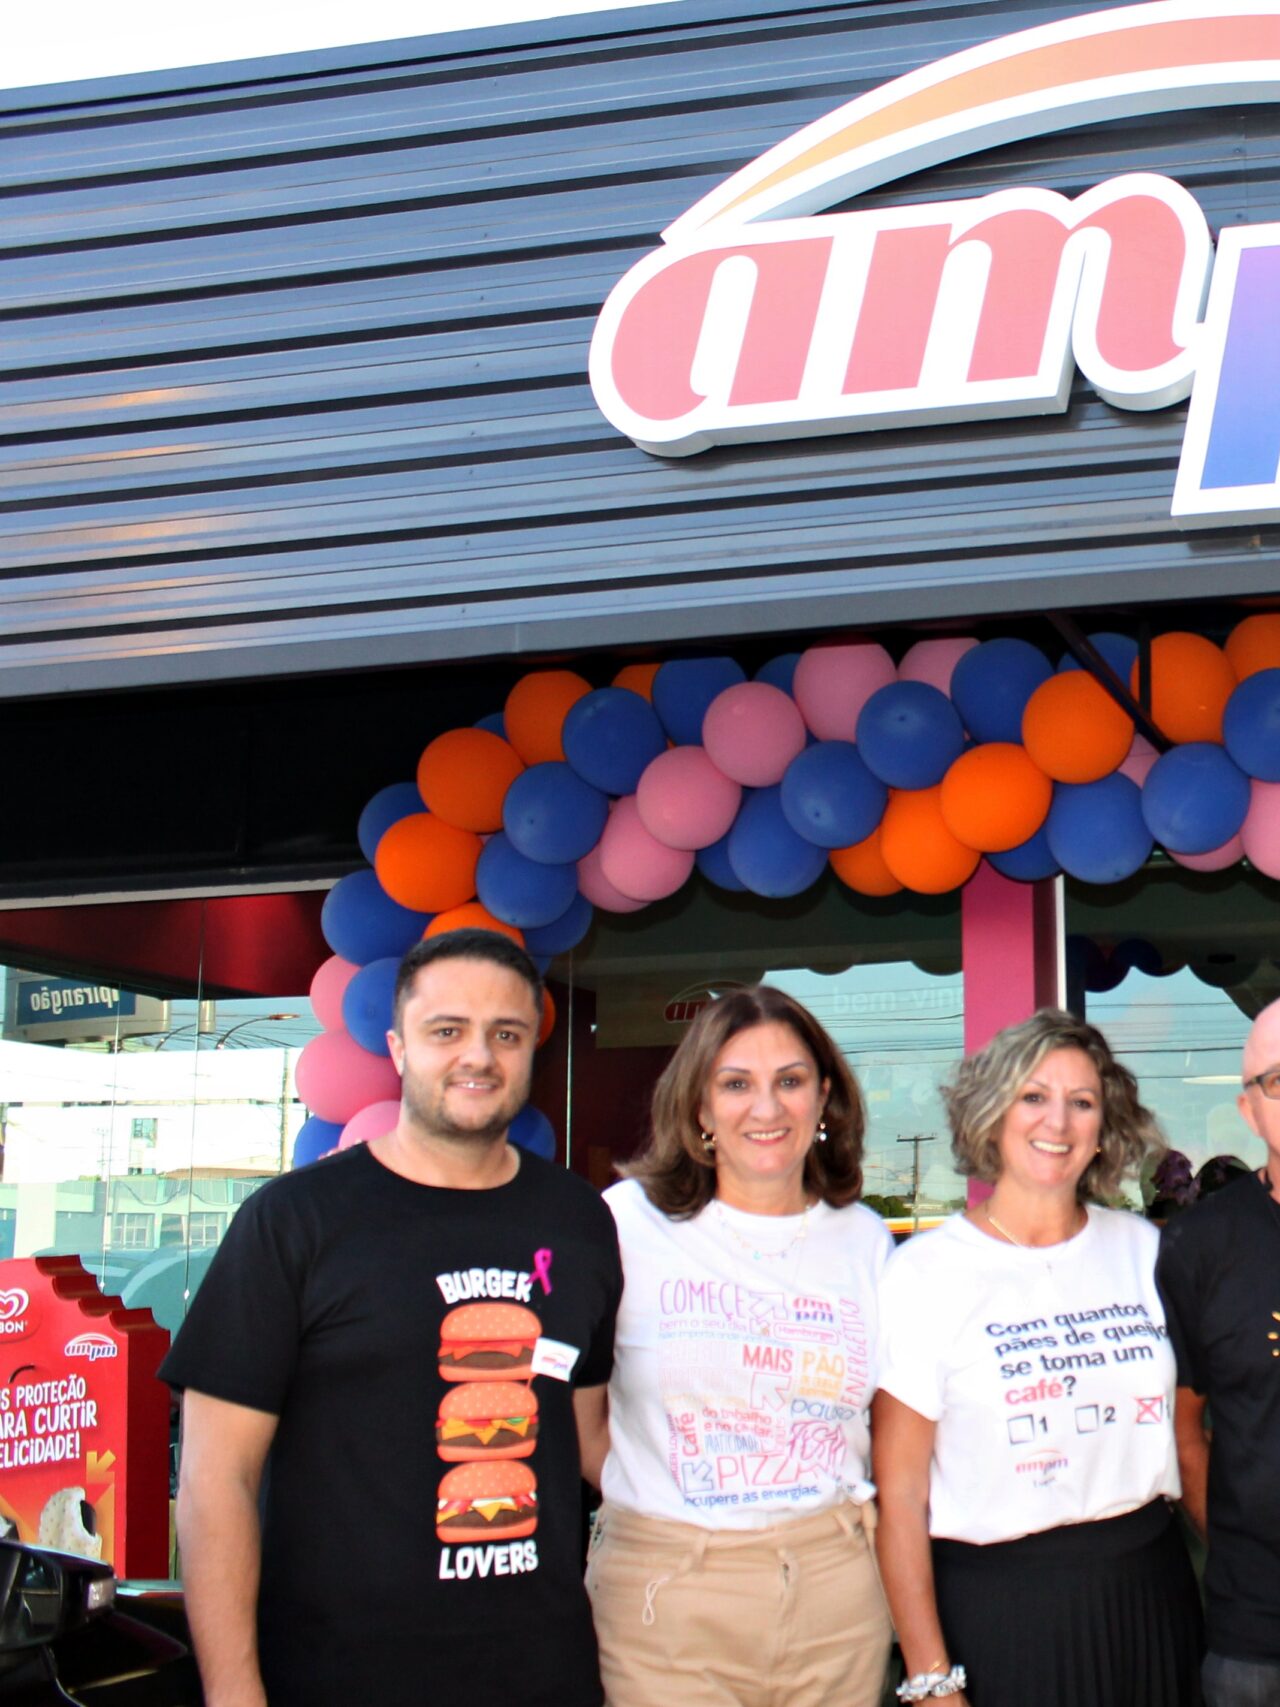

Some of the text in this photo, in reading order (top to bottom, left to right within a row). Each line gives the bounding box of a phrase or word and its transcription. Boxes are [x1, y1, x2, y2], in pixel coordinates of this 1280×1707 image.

[436, 1267, 533, 1304] BURGER
[985, 1303, 1150, 1337] Com quantos
[64, 1341, 118, 1361] ampm
[743, 1343, 795, 1373] MAIS
[994, 1335, 1059, 1358] pães
[1064, 1329, 1096, 1347] de
[802, 1346, 846, 1378] PÃO
[1000, 1344, 1155, 1380] se toma um
[16, 1373, 87, 1408] PROTEÇÃO
[1004, 1375, 1077, 1405] café?
[1038, 1405, 1117, 1433] 1 2
[716, 1453, 819, 1490] PIZZA
[743, 1491, 760, 1502] as
[438, 1539, 539, 1580] LOVERS
